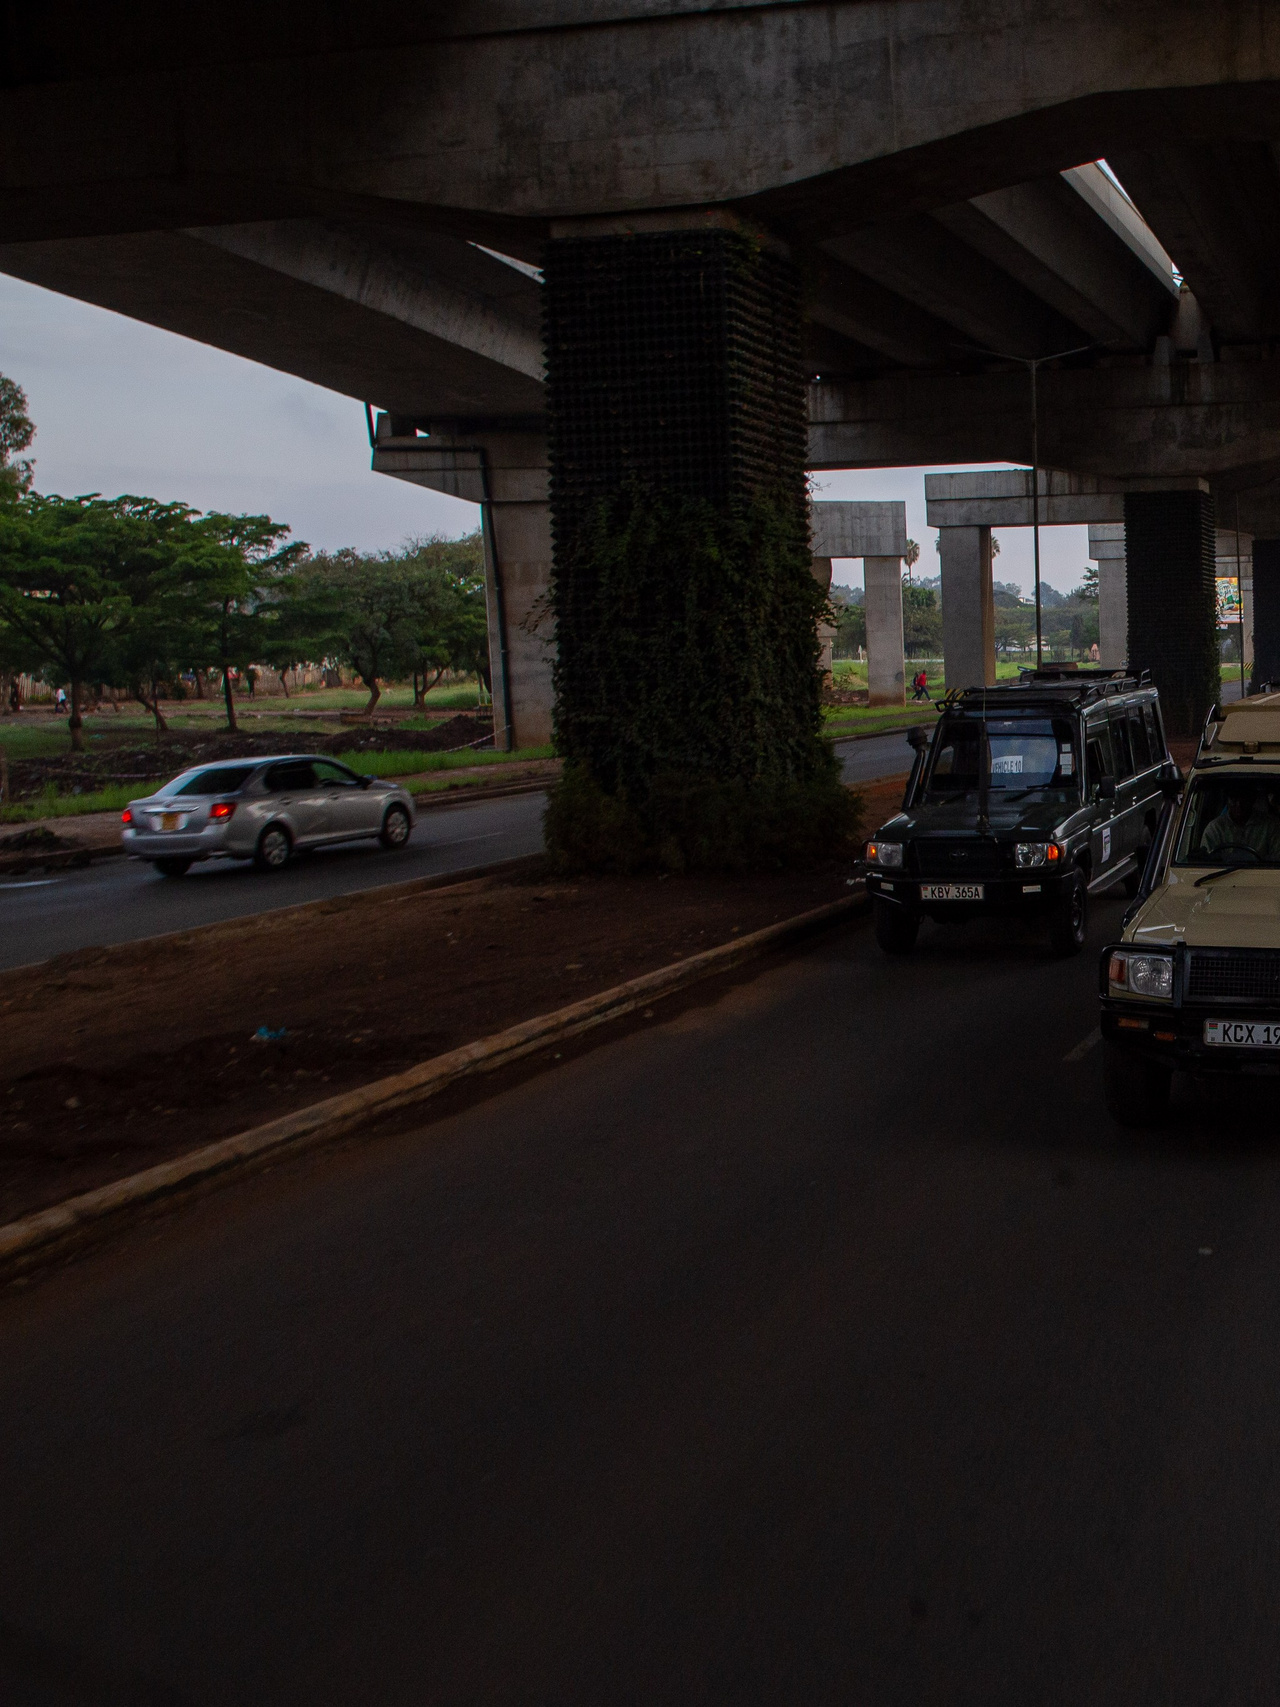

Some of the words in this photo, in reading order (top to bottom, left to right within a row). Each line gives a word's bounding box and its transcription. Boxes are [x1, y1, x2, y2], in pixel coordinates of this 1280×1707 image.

[931, 887, 950, 898] KBY
[955, 887, 980, 898] 365A
[1223, 1024, 1255, 1043] KCX
